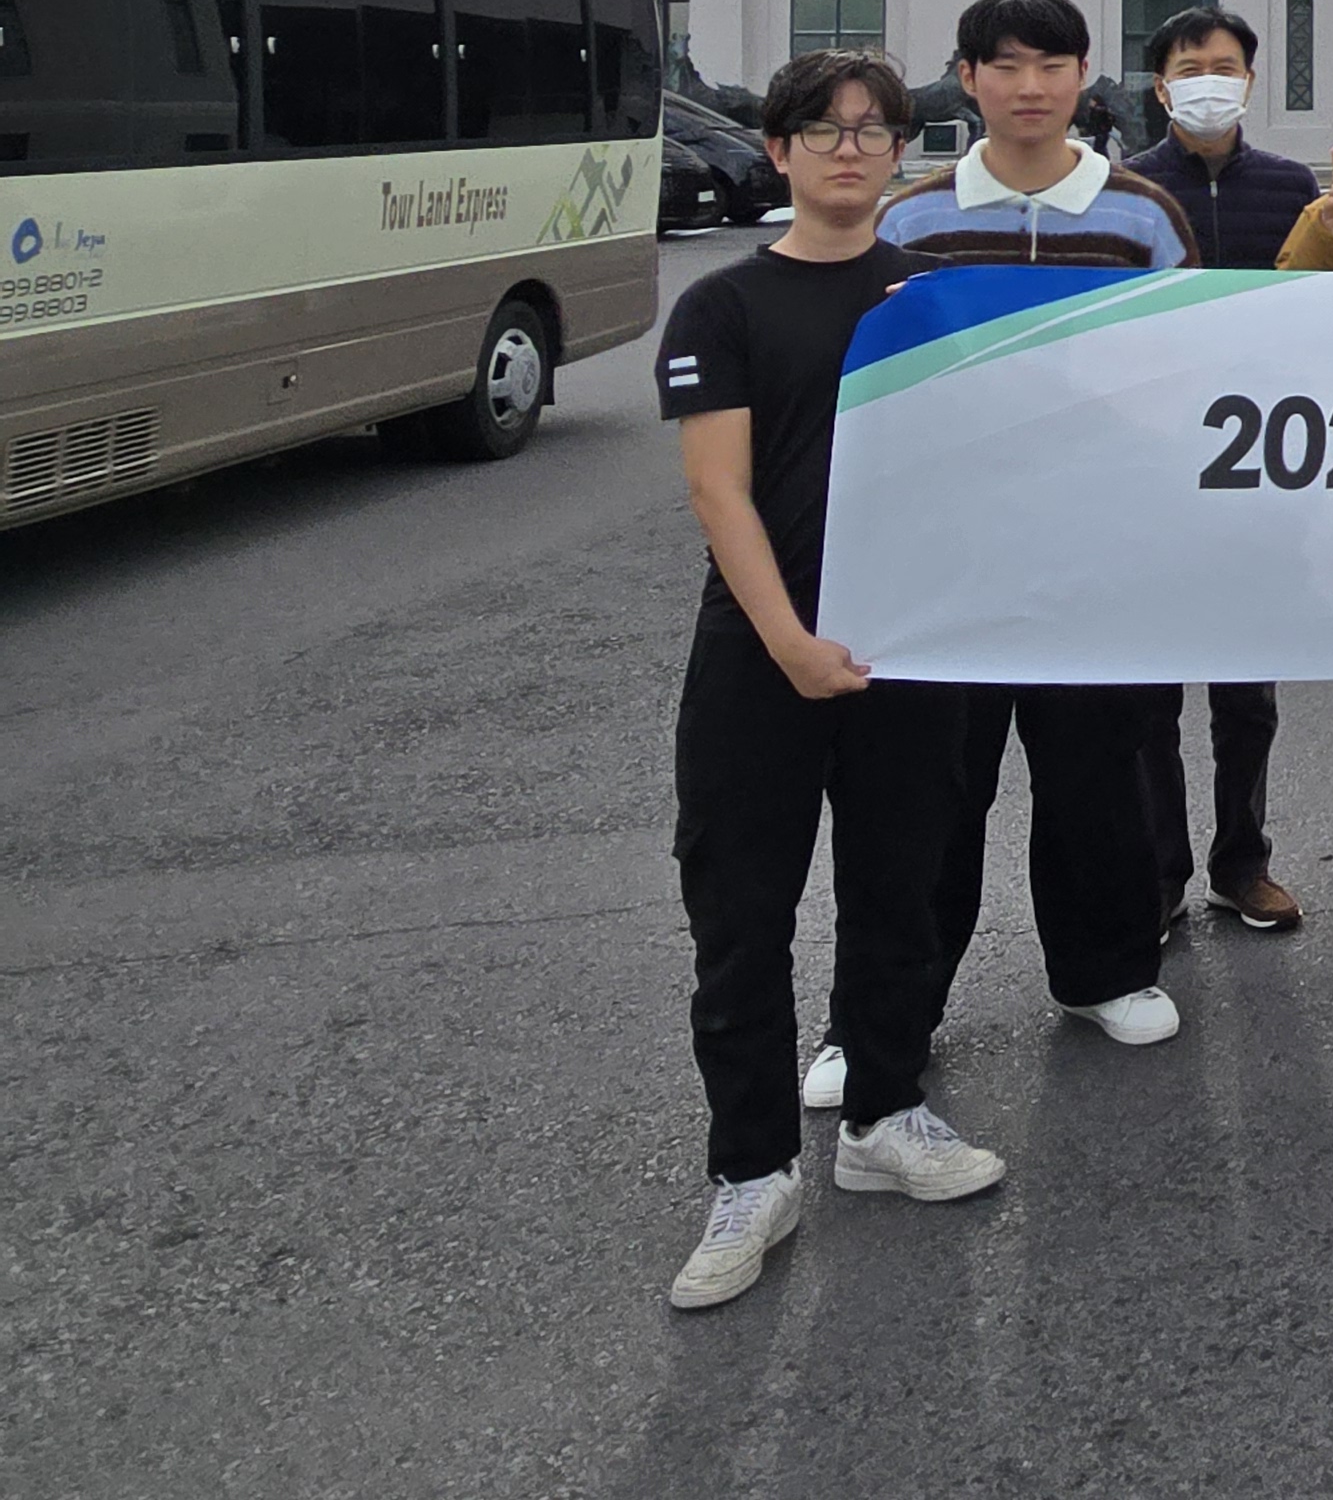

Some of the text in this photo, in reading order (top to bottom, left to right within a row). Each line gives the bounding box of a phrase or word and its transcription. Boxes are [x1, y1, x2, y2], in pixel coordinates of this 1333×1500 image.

[381, 177, 508, 235] Tour Land Express
